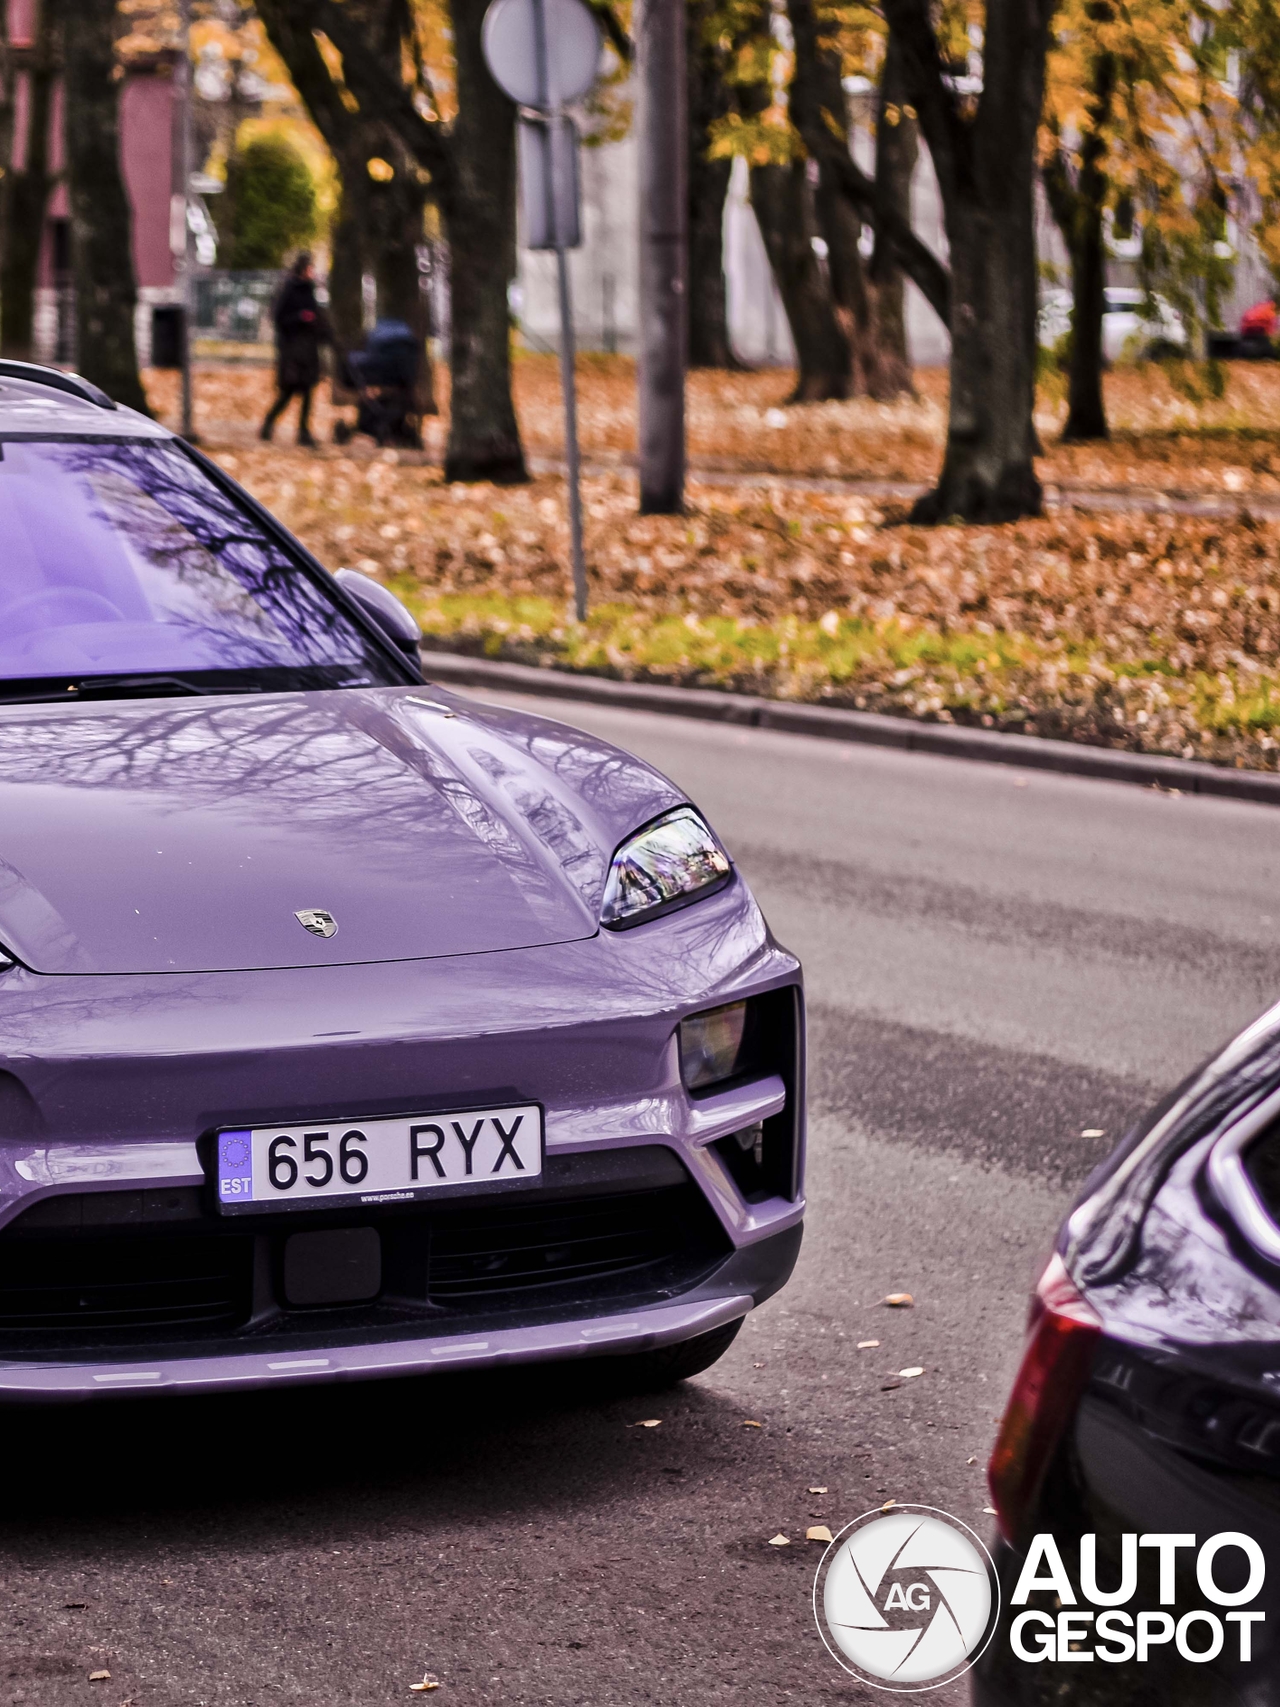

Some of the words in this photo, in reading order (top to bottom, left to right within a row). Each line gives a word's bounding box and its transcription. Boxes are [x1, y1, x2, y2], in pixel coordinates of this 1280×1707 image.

[268, 1129, 368, 1191] 656
[409, 1114, 525, 1181] RYX
[221, 1177, 251, 1195] EST
